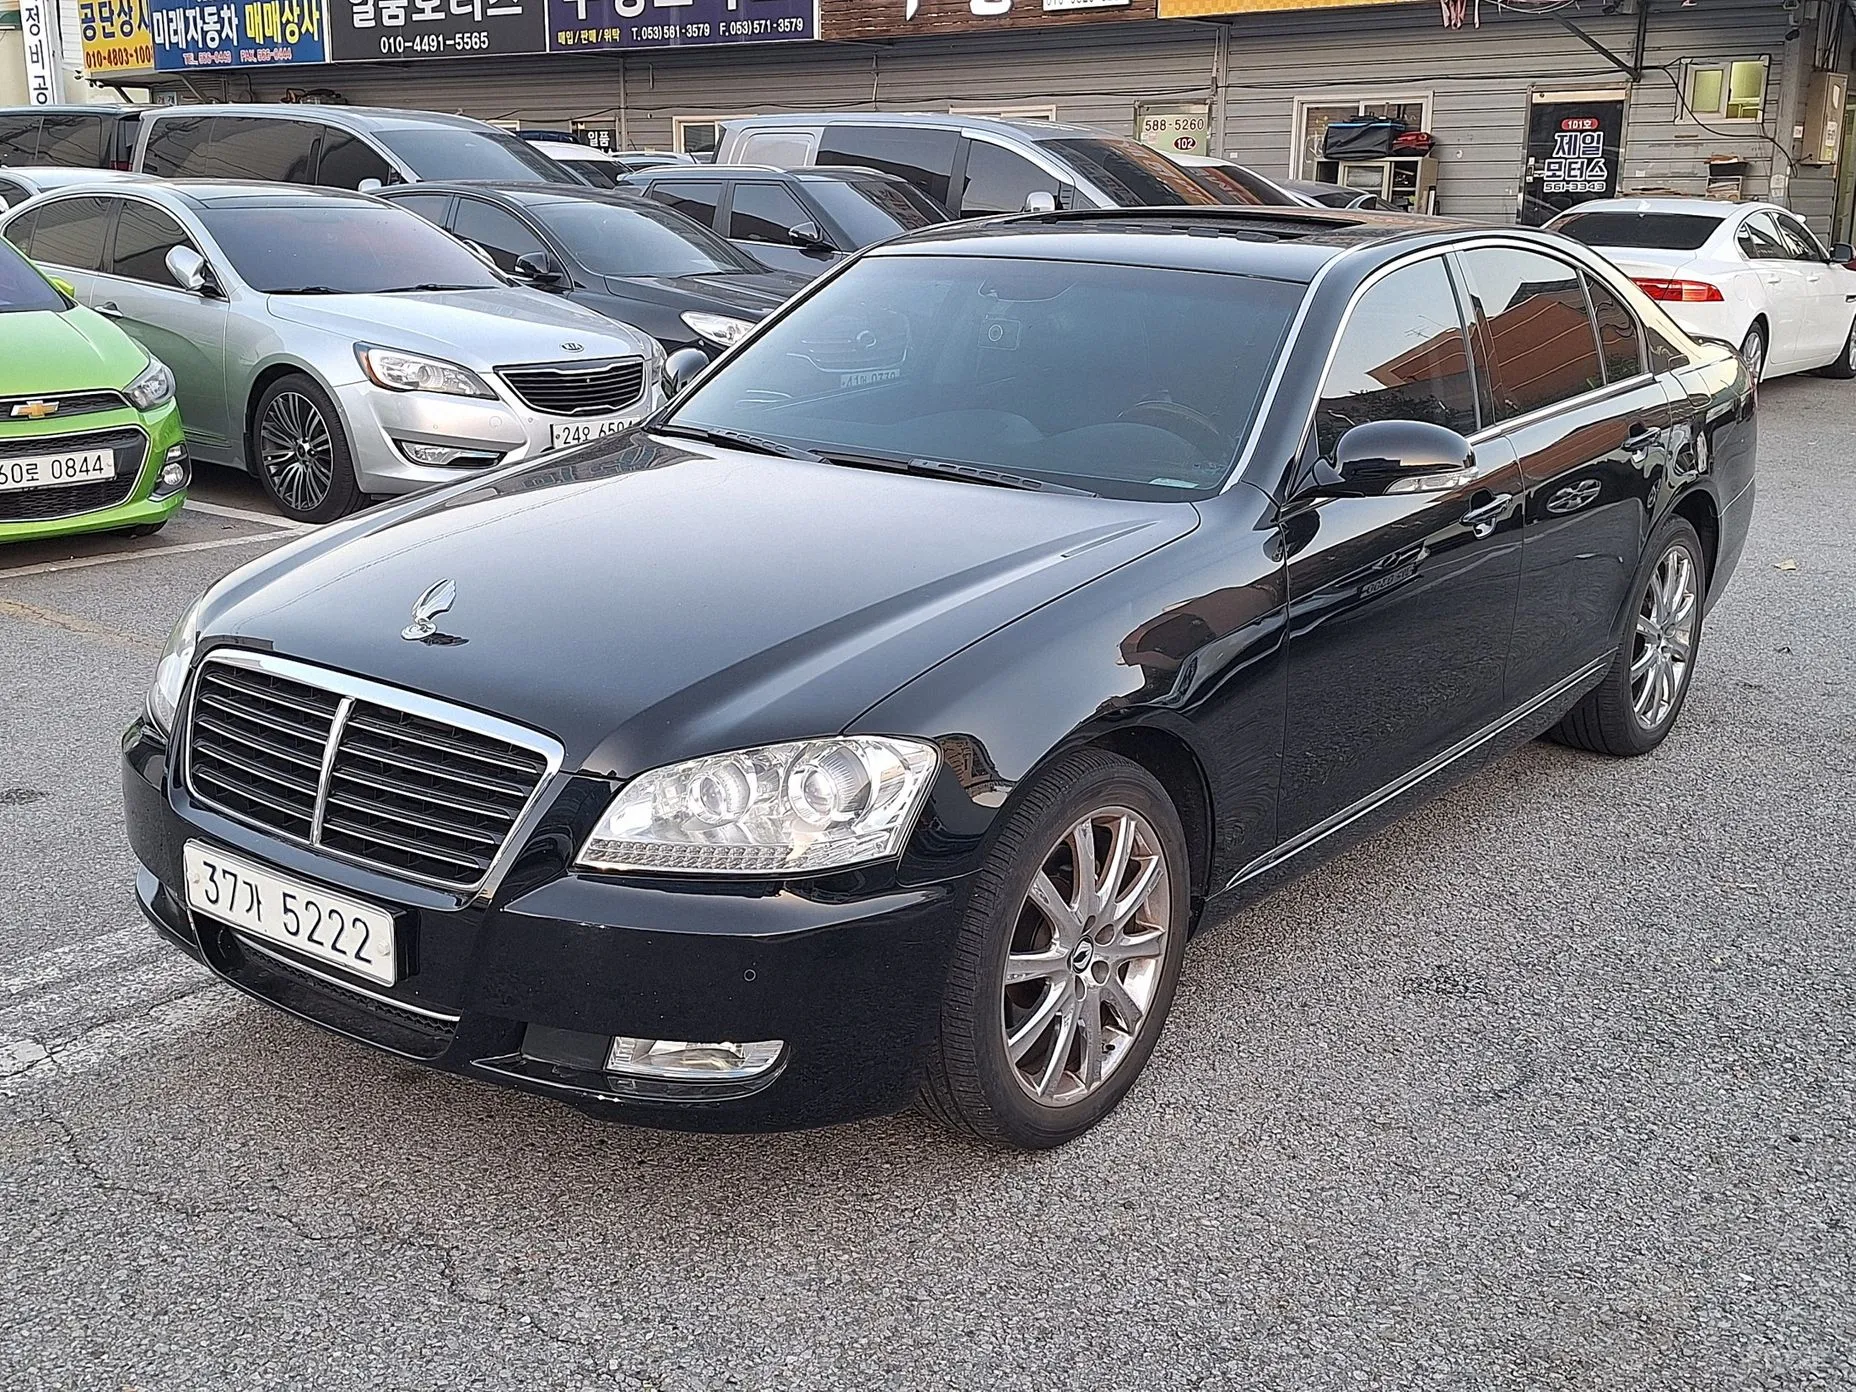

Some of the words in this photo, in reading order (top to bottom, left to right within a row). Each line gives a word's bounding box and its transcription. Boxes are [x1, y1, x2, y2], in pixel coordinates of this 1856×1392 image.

[152, 3, 239, 50] 미래자동차
[244, 0, 321, 45] 매매상사
[379, 32, 489, 54] 010-4491-5565
[85, 45, 153, 69] 010-4803-100
[1144, 118, 1205, 132] 588-5260
[1567, 119, 1592, 130] 101호
[587, 131, 610, 147] 일품
[1176, 138, 1194, 150] 102
[1552, 131, 1604, 158] 제일
[1543, 157, 1608, 181] 모터스
[1543, 181, 1607, 193] 561-3343
[51, 454, 104, 480] 0844
[202, 860, 264, 924] 37가
[281, 890, 373, 966] 5222
